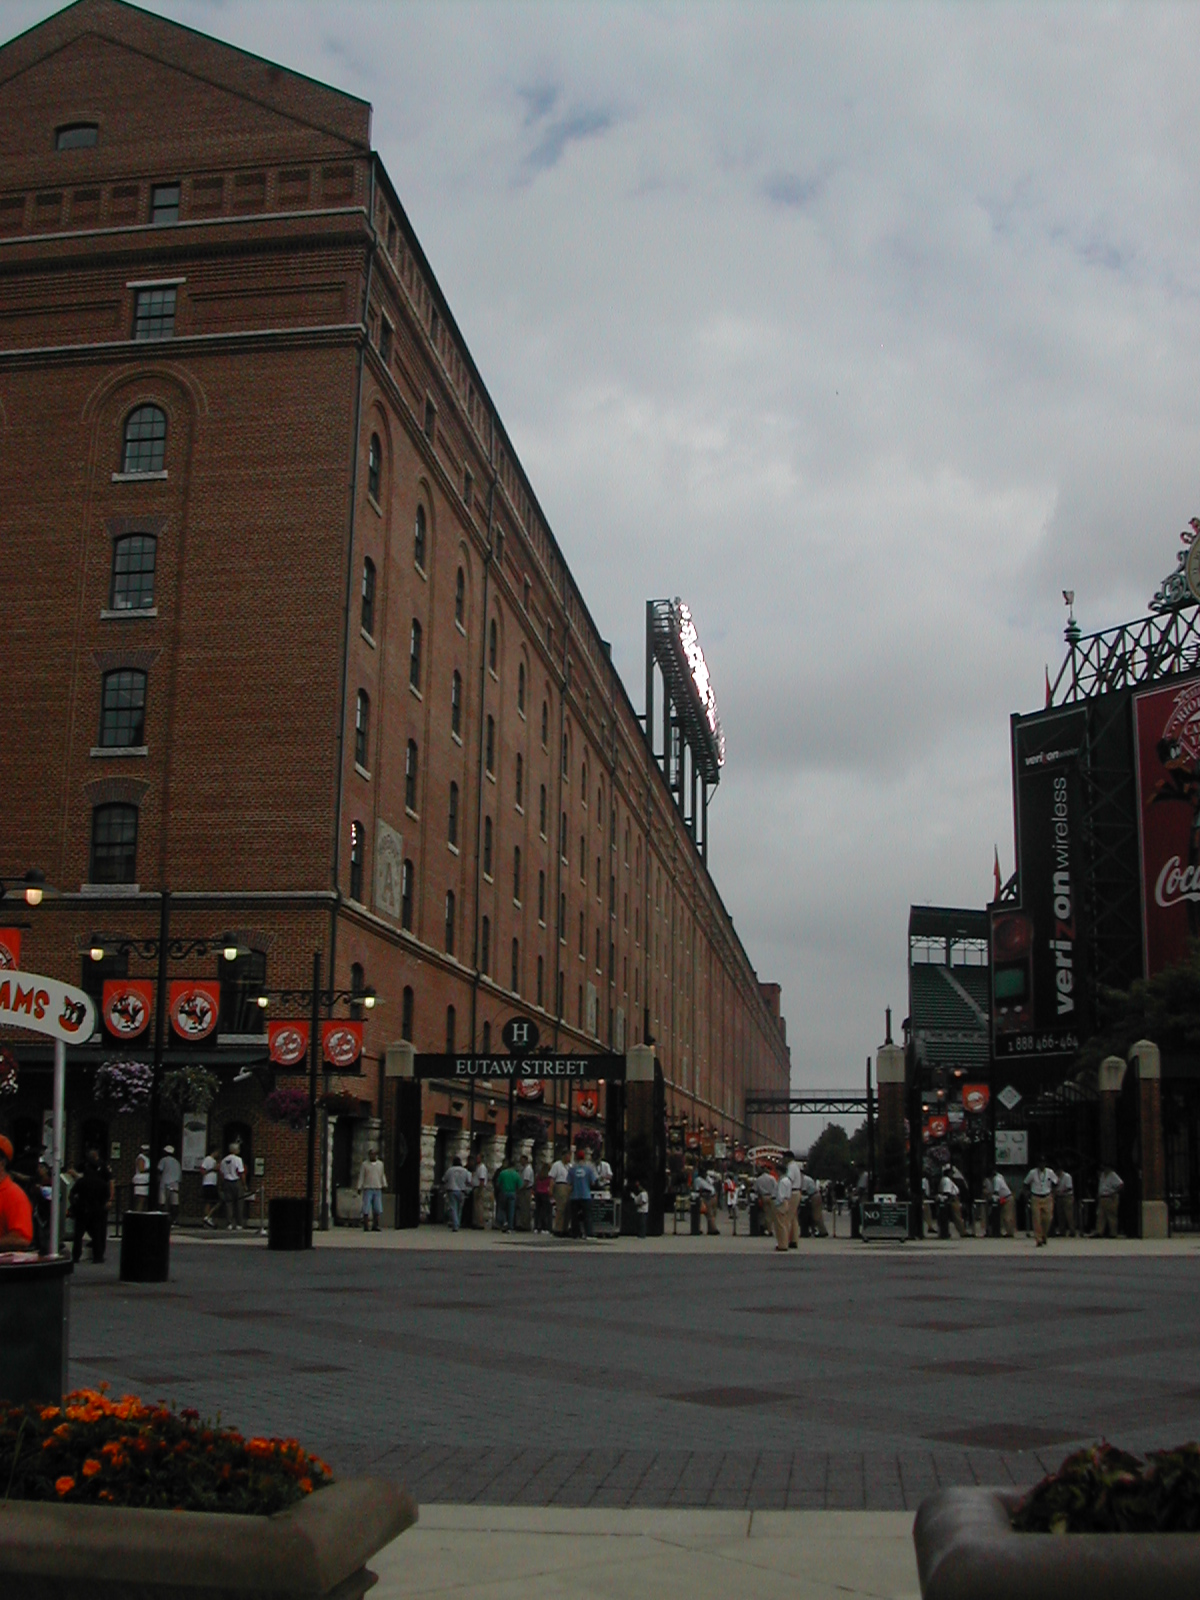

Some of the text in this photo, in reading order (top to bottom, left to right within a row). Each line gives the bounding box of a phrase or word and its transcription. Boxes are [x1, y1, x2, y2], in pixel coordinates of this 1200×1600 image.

[511, 1022, 529, 1042] H
[1015, 1035, 1034, 1051] 888
[455, 1059, 588, 1075] EUTAW STREET
[864, 1210, 880, 1221] NO
